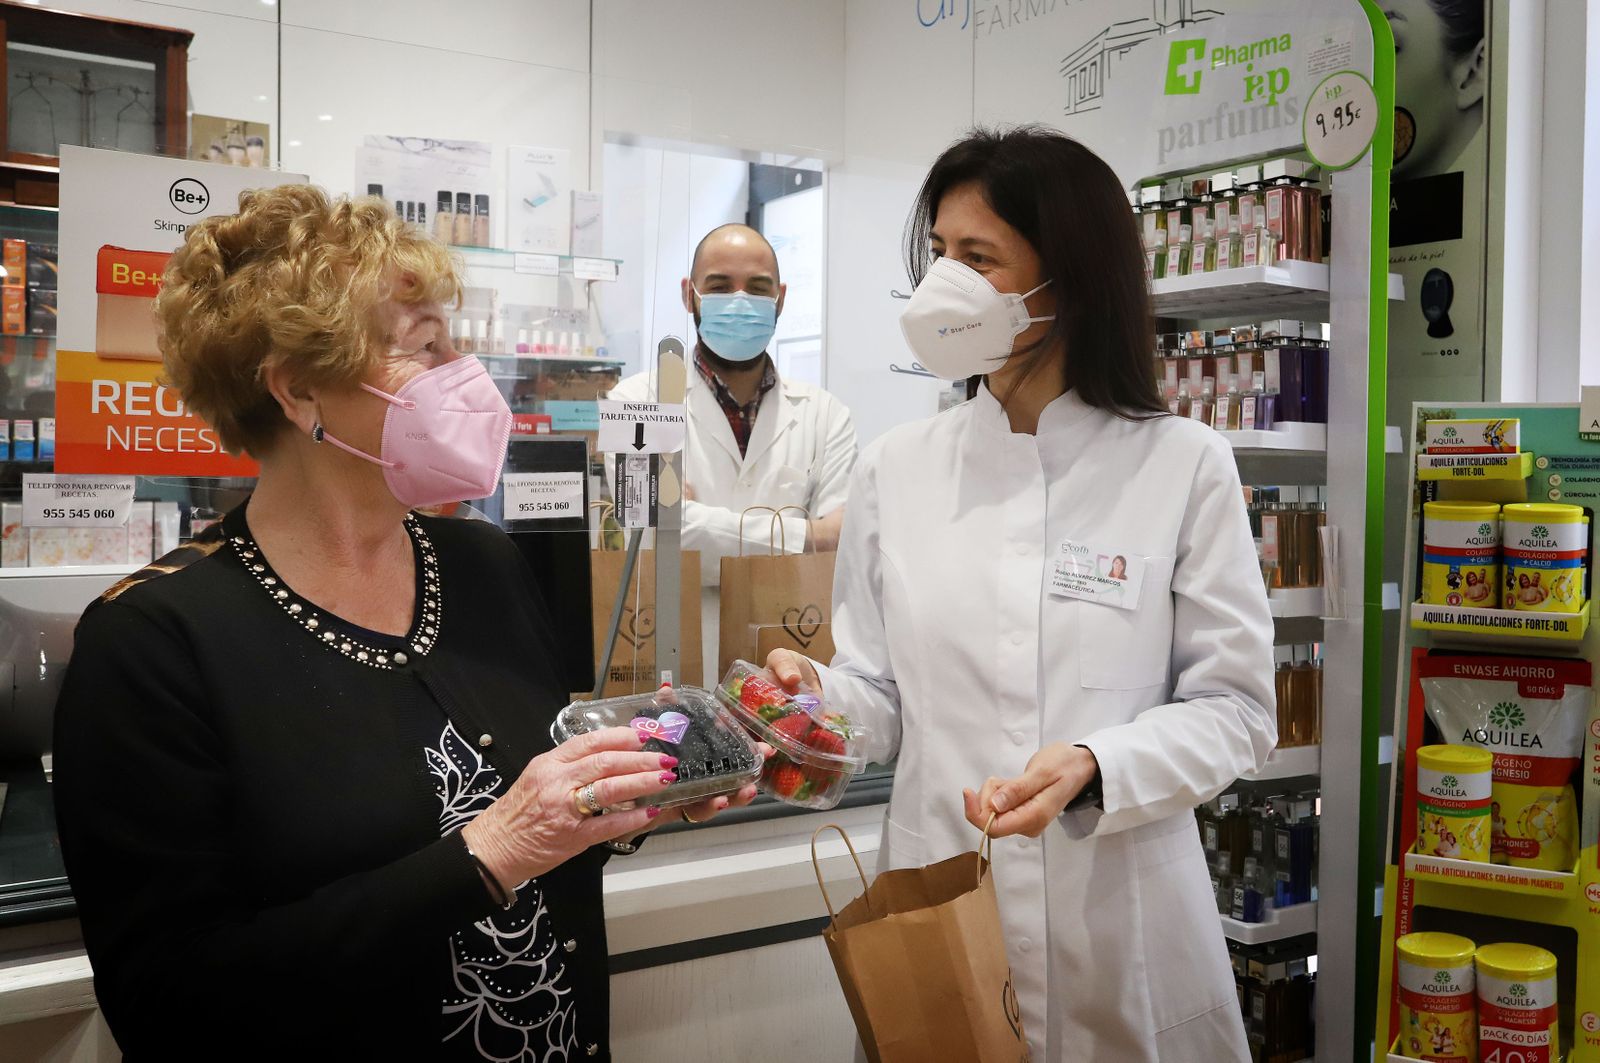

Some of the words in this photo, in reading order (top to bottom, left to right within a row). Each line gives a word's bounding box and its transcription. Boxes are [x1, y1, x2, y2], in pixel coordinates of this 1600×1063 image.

[1211, 33, 1292, 70] Pharma
[1157, 96, 1299, 165] parfums
[174, 188, 205, 204] Be+
[91, 379, 192, 417] REG
[623, 403, 659, 412] INSERTE
[600, 413, 637, 422] TARJETA
[639, 414, 684, 423] SANITARIA
[106, 425, 229, 454] NECES
[405, 432, 429, 441] KN95
[1430, 458, 1455, 467] AQUILEA
[1456, 457, 1508, 466] ARTICULACIONES
[1452, 467, 1485, 476] FORTE-DOL
[27, 482, 70, 490] TELEFONO
[519, 503, 535, 511] 955
[536, 503, 552, 511] 545
[554, 502, 570, 510] 060
[43, 508, 65, 518] 955
[68, 508, 90, 518] 545
[94, 509, 115, 518] 060
[1466, 537, 1496, 546] AQUILEA
[1518, 539, 1557, 548] AQUILEA
[1071, 571, 1097, 581] ALVAREZ
[1097, 577, 1121, 587] MARCOS
[1423, 611, 1454, 624] AQUILEA
[1457, 614, 1522, 629] ARTICULACIONES
[1525, 620, 1569, 632] FORTE-DOL
[1454, 664, 1499, 677] ENVASE
[1502, 666, 1555, 679] AHORRO
[1462, 728, 1543, 749] AQUILEA
[1430, 787, 1467, 797] AQUILEA
[1414, 863, 1440, 875] AQUILEA
[1441, 866, 1494, 881] ARTICULACIONES
[1422, 984, 1460, 993] AQUILEA
[1497, 996, 1537, 1006] AQUILEA
[1483, 1029, 1509, 1040] PACK
[1511, 1034, 1524, 1043] 60
[1526, 1032, 1548, 1043] DÍAS
